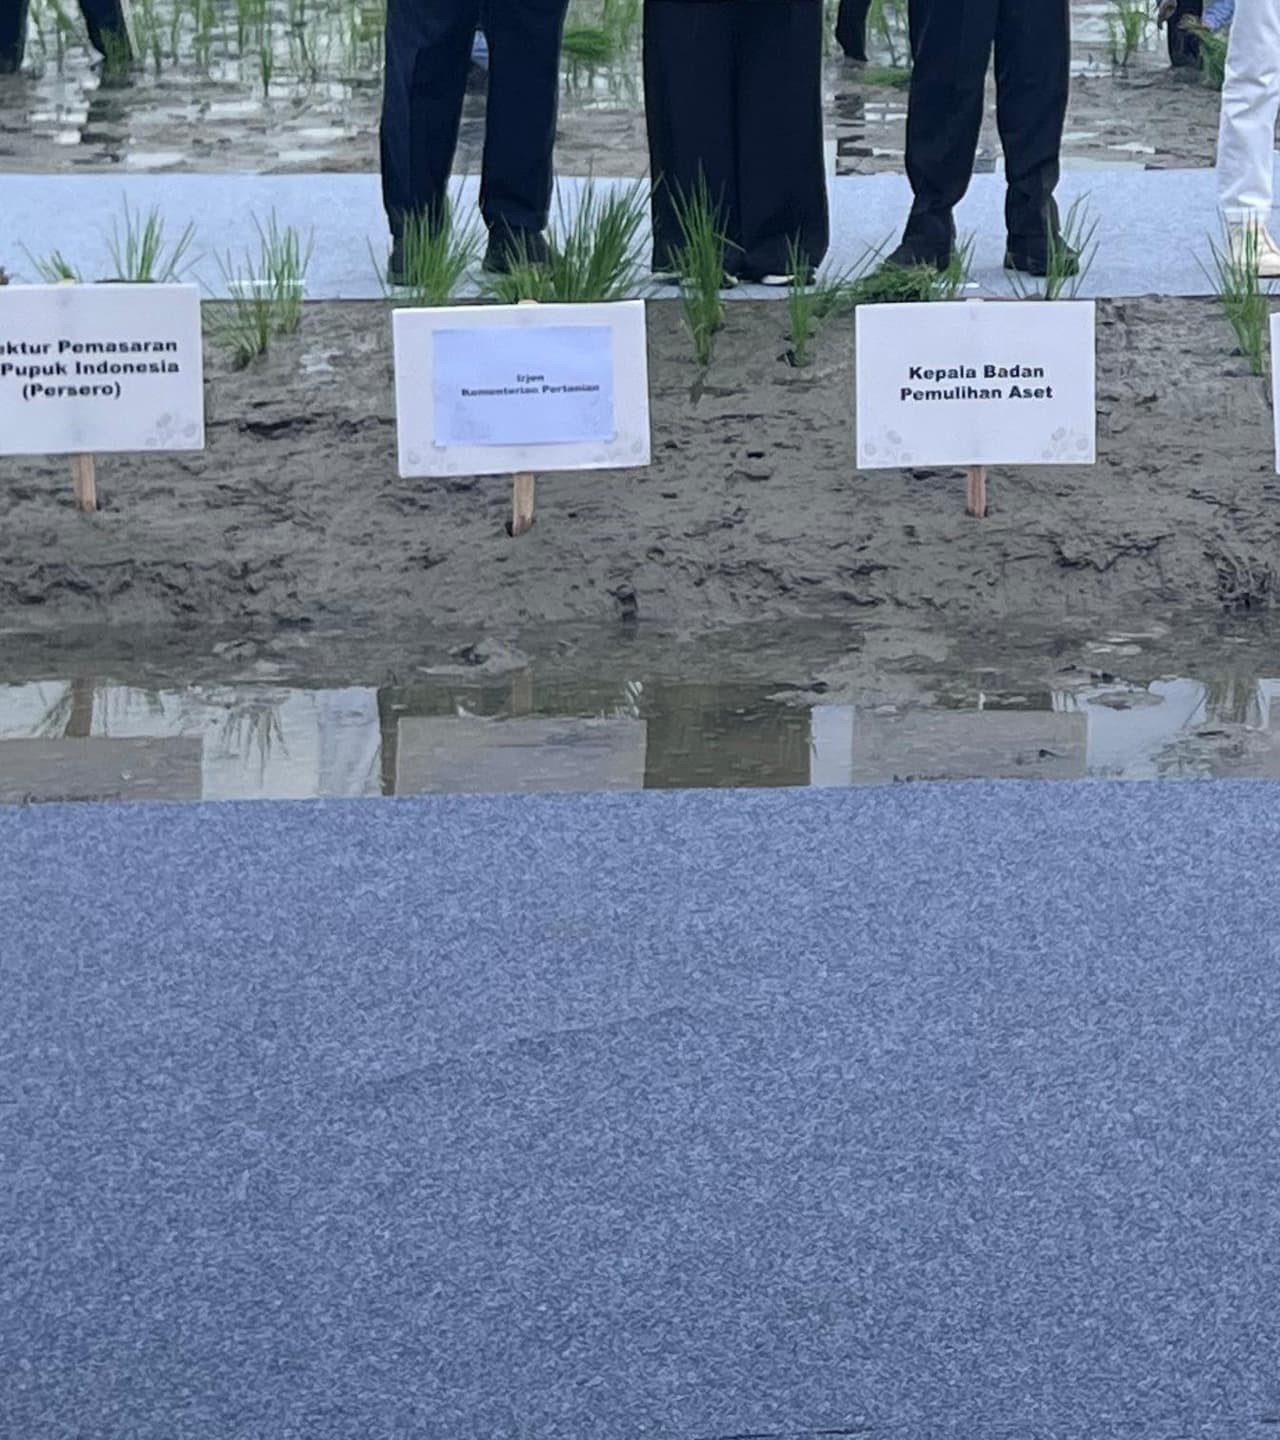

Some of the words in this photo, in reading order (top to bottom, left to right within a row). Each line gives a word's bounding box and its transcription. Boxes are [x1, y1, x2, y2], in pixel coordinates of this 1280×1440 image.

[58, 340, 178, 354] Pemasaran
[1, 361, 67, 378] Pupuk
[75, 360, 180, 375] Indonesia
[908, 365, 977, 382] Kepala
[983, 364, 1045, 378] Badan
[22, 381, 121, 401] (Persero)
[900, 386, 1002, 401] Pemulihan
[1008, 385, 1053, 399] Aset
